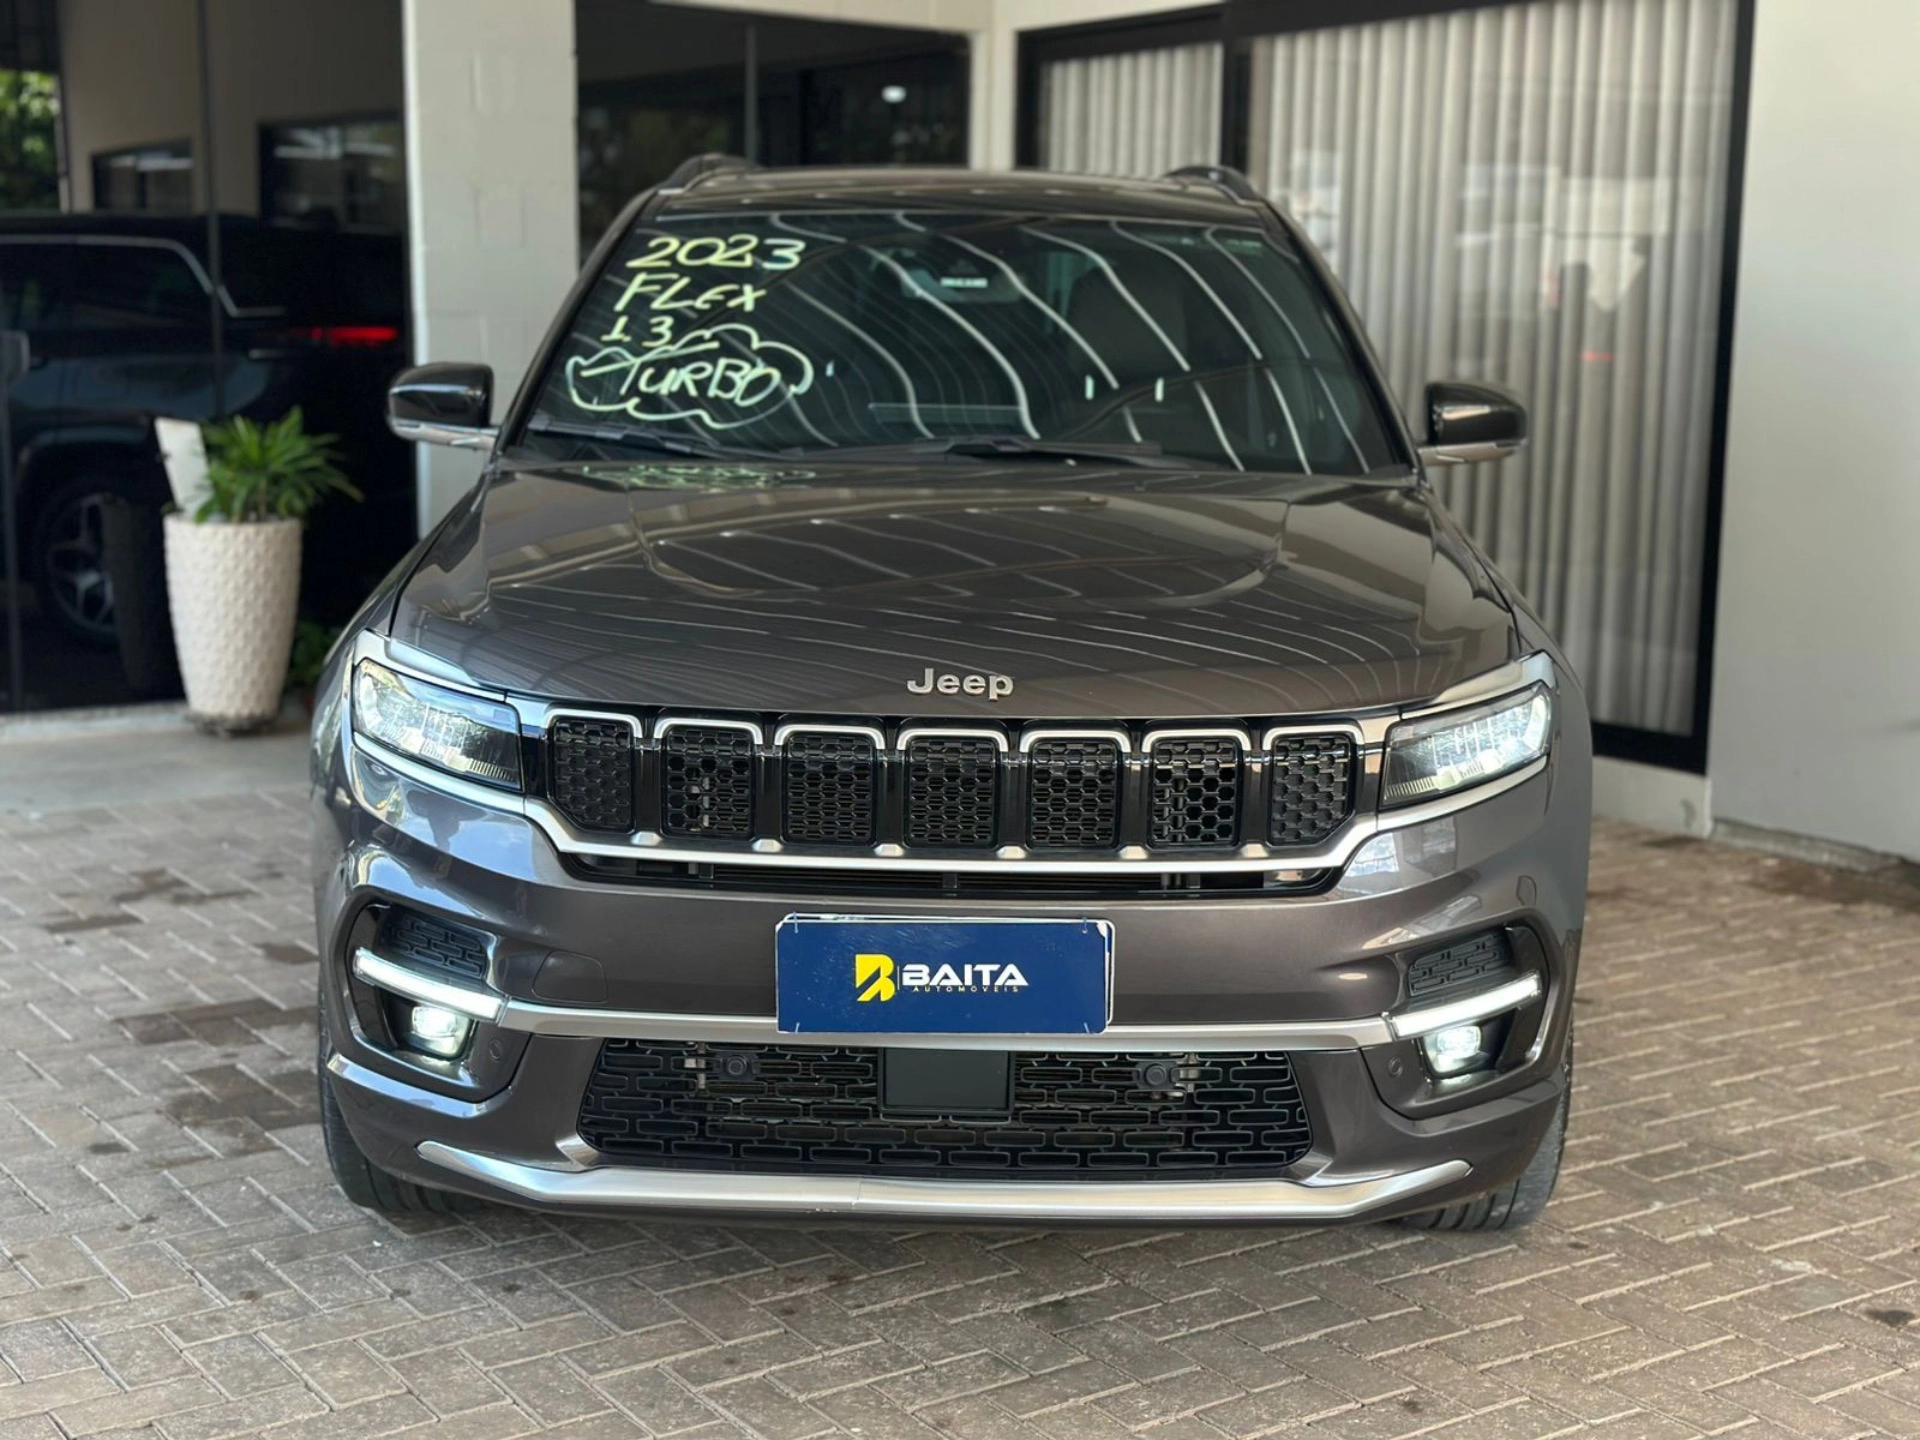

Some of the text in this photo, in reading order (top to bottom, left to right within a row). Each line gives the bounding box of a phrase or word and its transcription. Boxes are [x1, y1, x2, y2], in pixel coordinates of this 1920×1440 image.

[626, 234, 806, 270] 2023
[614, 272, 767, 312] FLEX
[580, 341, 782, 407] TURBO
[906, 667, 1014, 700] Jeep
[902, 963, 1029, 986] BAITA
